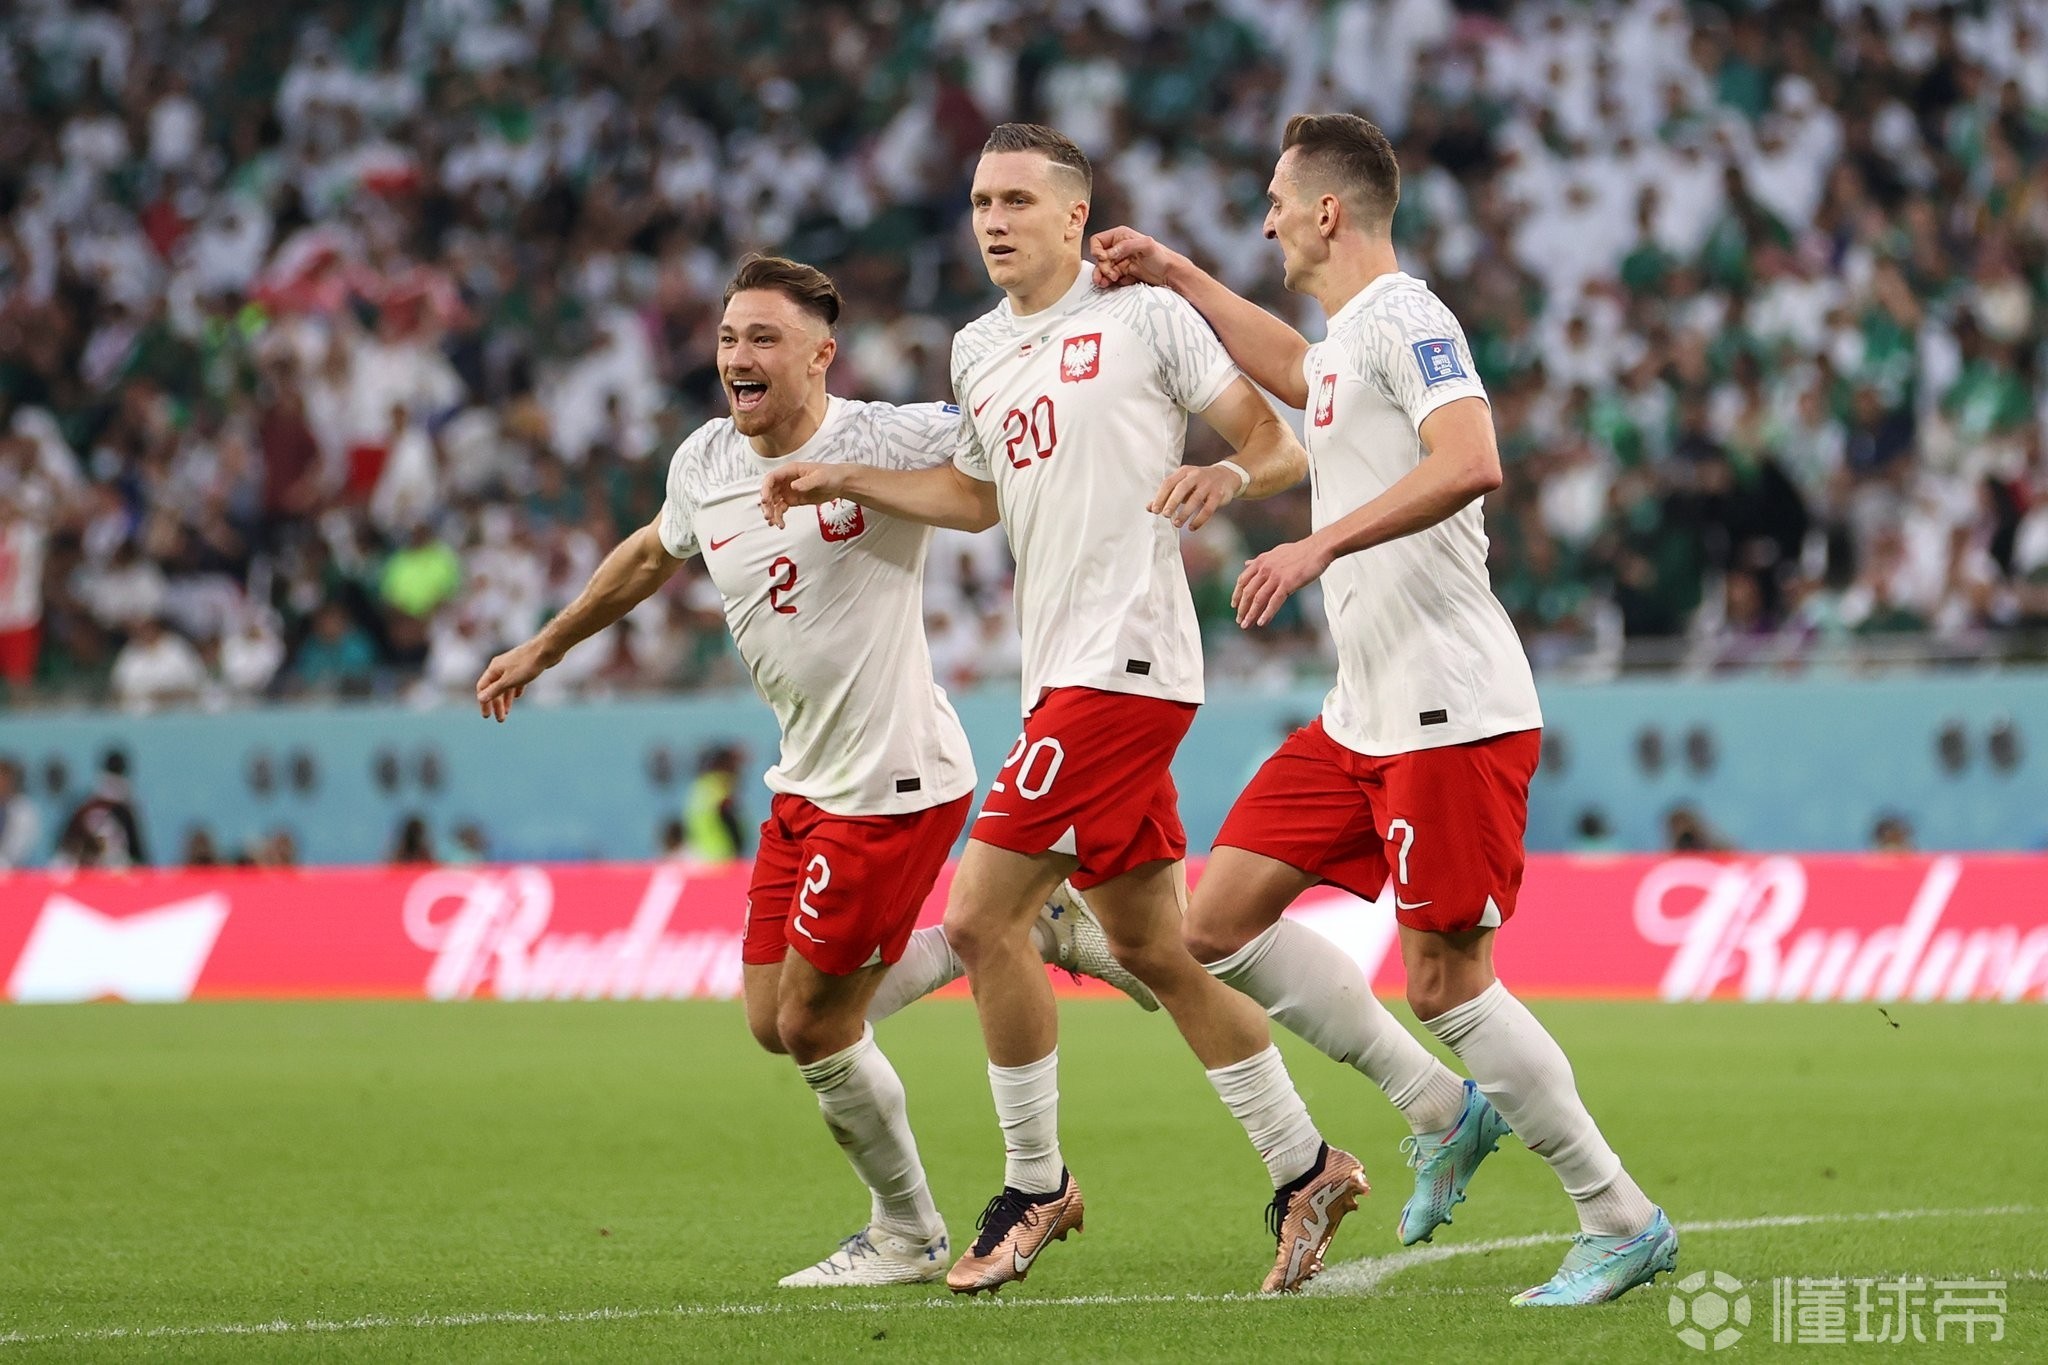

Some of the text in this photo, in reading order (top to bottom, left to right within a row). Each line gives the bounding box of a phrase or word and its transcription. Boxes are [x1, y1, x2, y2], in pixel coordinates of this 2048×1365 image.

[1003, 395, 1058, 470] 20
[768, 556, 798, 615] 2
[1386, 818, 1415, 885] 7
[799, 853, 832, 919] 2
